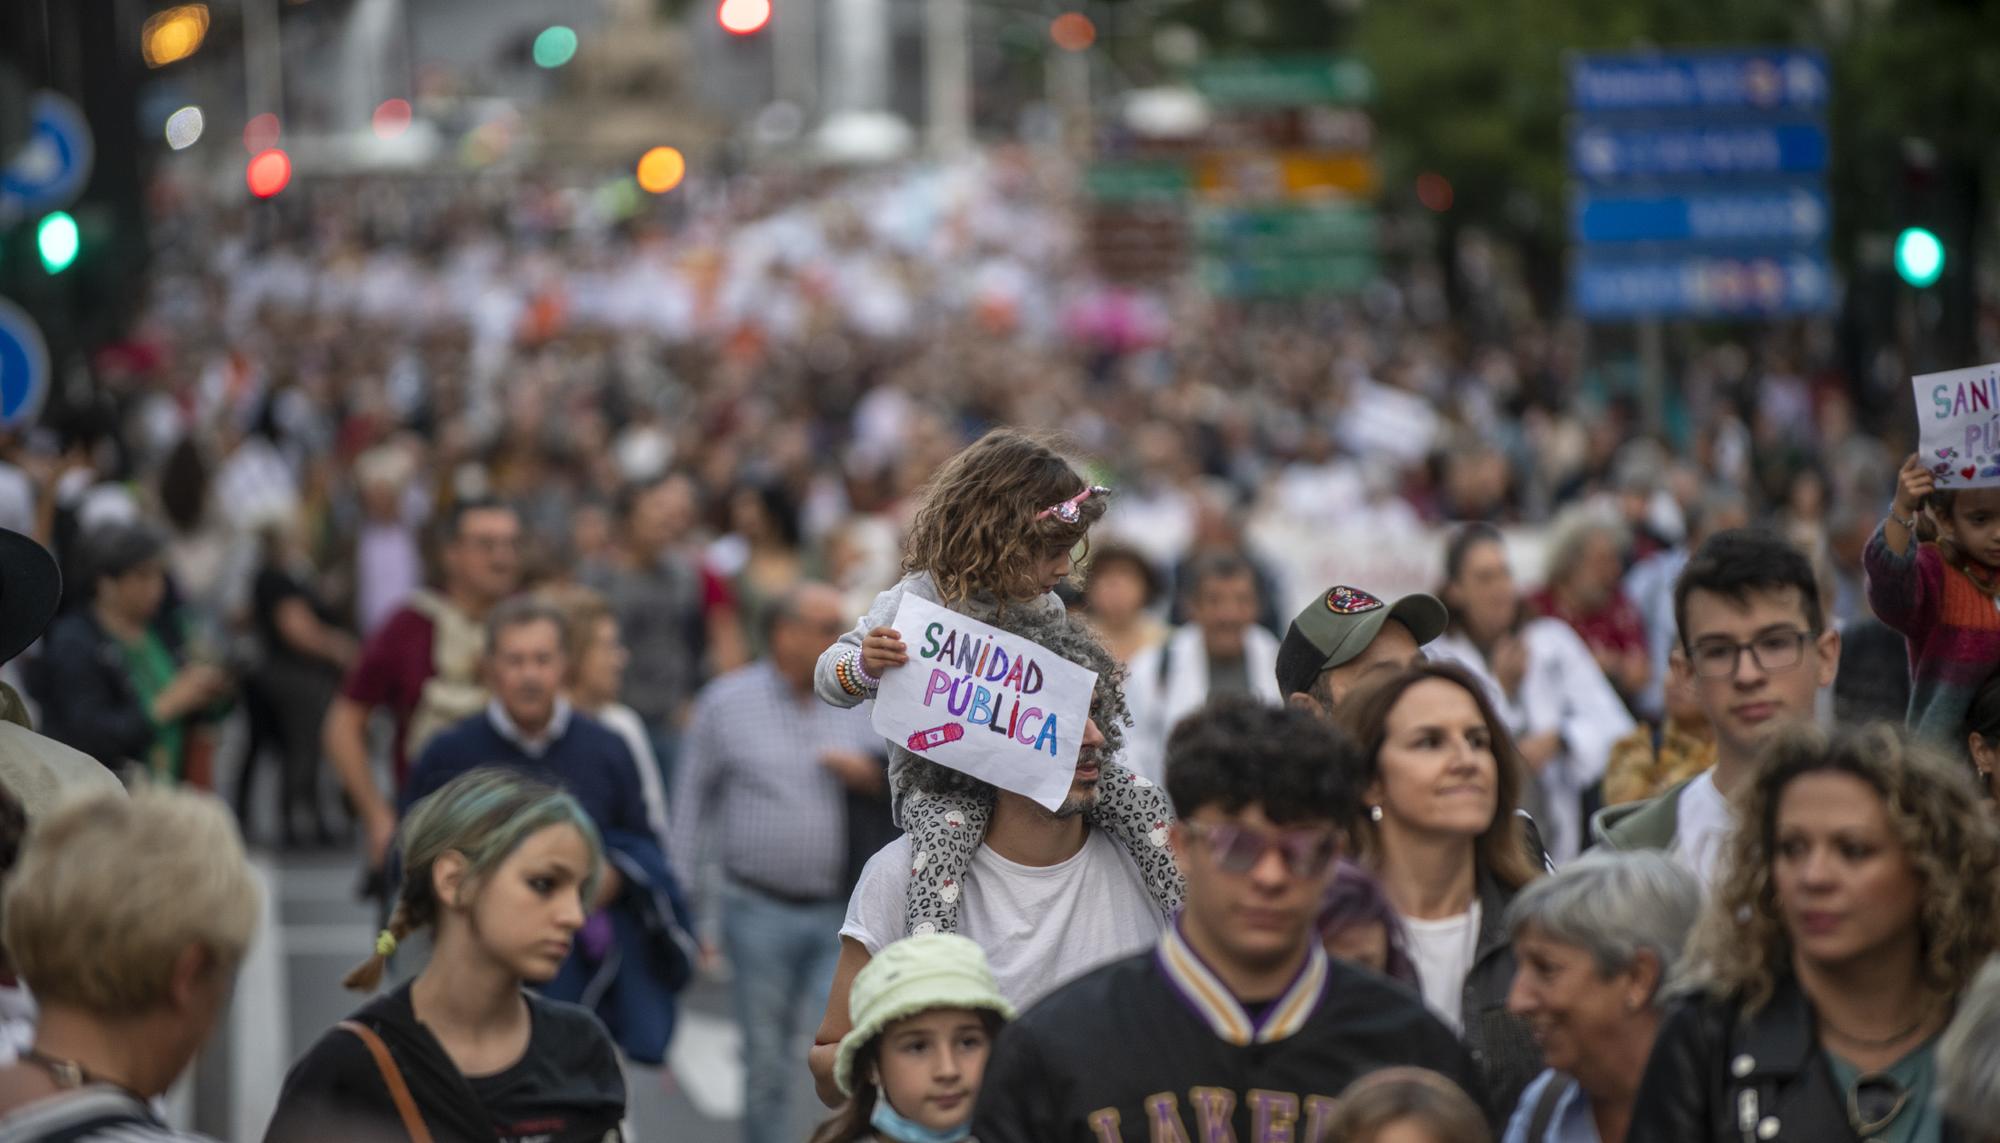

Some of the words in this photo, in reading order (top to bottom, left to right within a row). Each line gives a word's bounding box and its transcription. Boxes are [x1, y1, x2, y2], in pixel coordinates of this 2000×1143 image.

[1932, 370, 2000, 419] SANI
[1965, 413, 2000, 459] PÚ
[920, 622, 1043, 694] SANIDAD
[923, 668, 1057, 757] PÚBLICA
[1088, 1086, 1340, 1143] AKE
